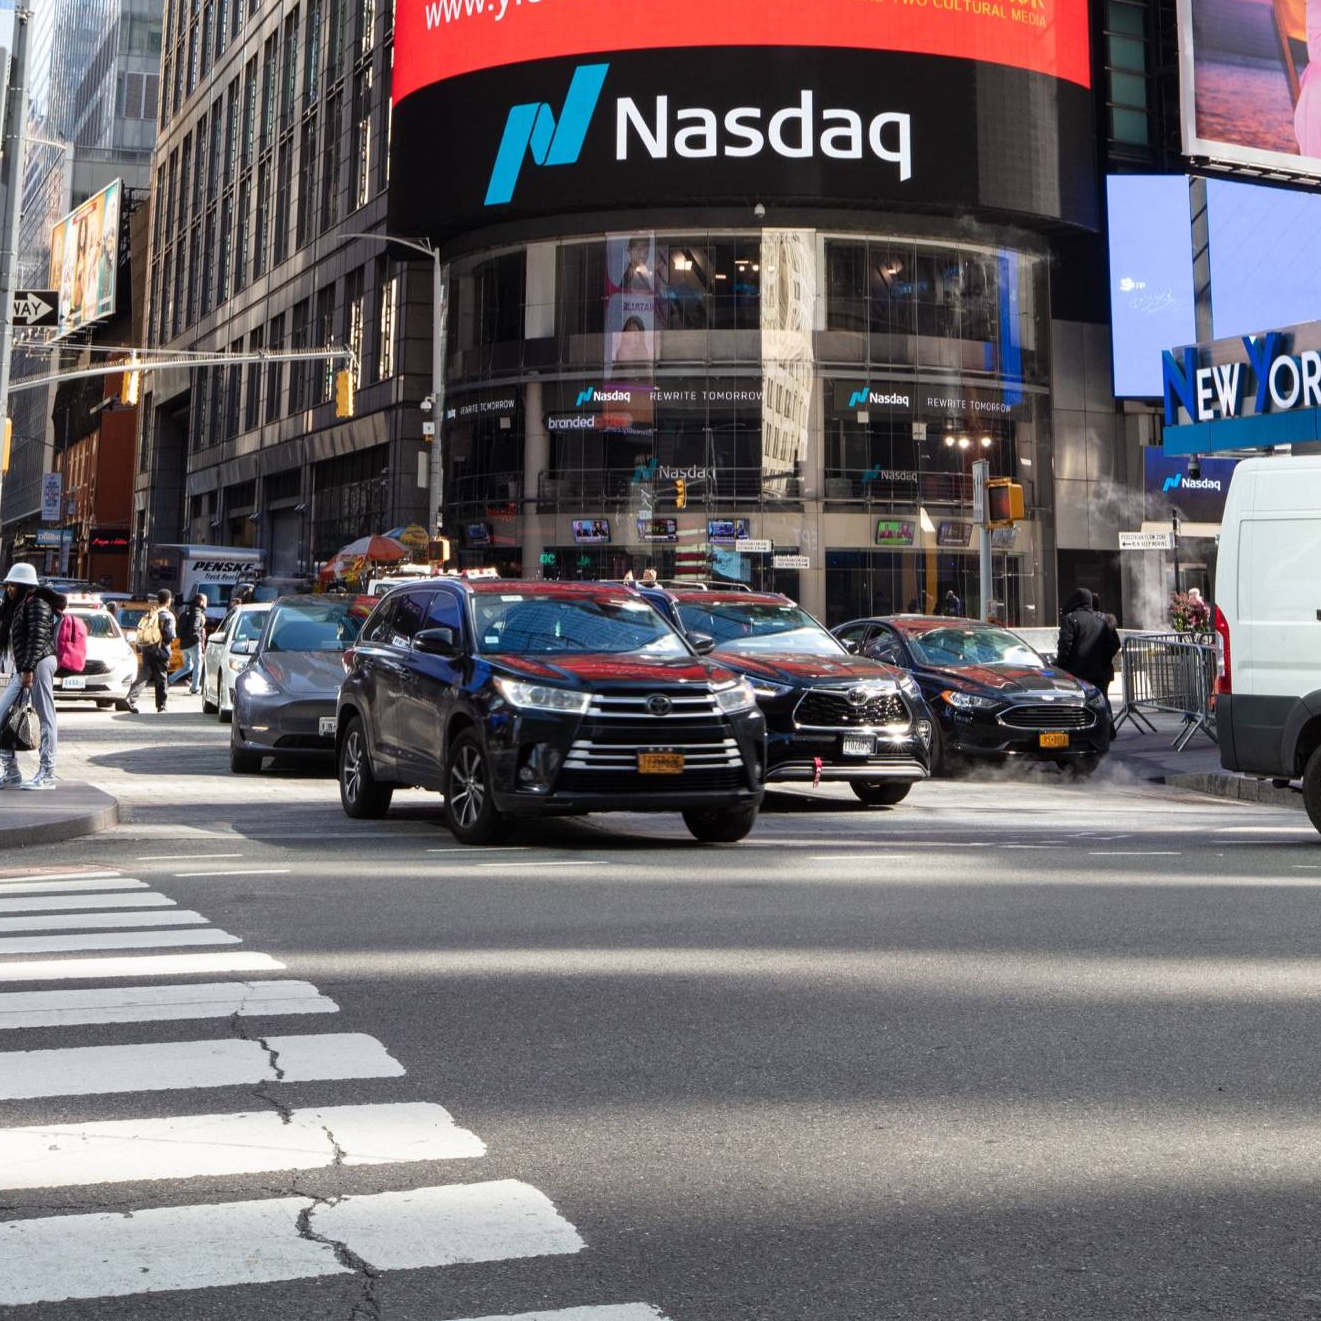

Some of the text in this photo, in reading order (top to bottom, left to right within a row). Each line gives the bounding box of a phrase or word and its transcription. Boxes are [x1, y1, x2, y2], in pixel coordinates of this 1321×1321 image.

[1011, 8, 1046, 28] MEDIA
[616, 89, 912, 182] Nasdaq
[1162, 346, 1246, 425] NEW
[593, 390, 764, 403] Nasdaq REWRITE TOMORROW
[869, 392, 1012, 414] Nasdaq REWRITE TOMORROW
[881, 470, 918, 484] Nasdaq
[1182, 478, 1221, 491] Nasdaq
[192, 560, 255, 572] PENSKE
